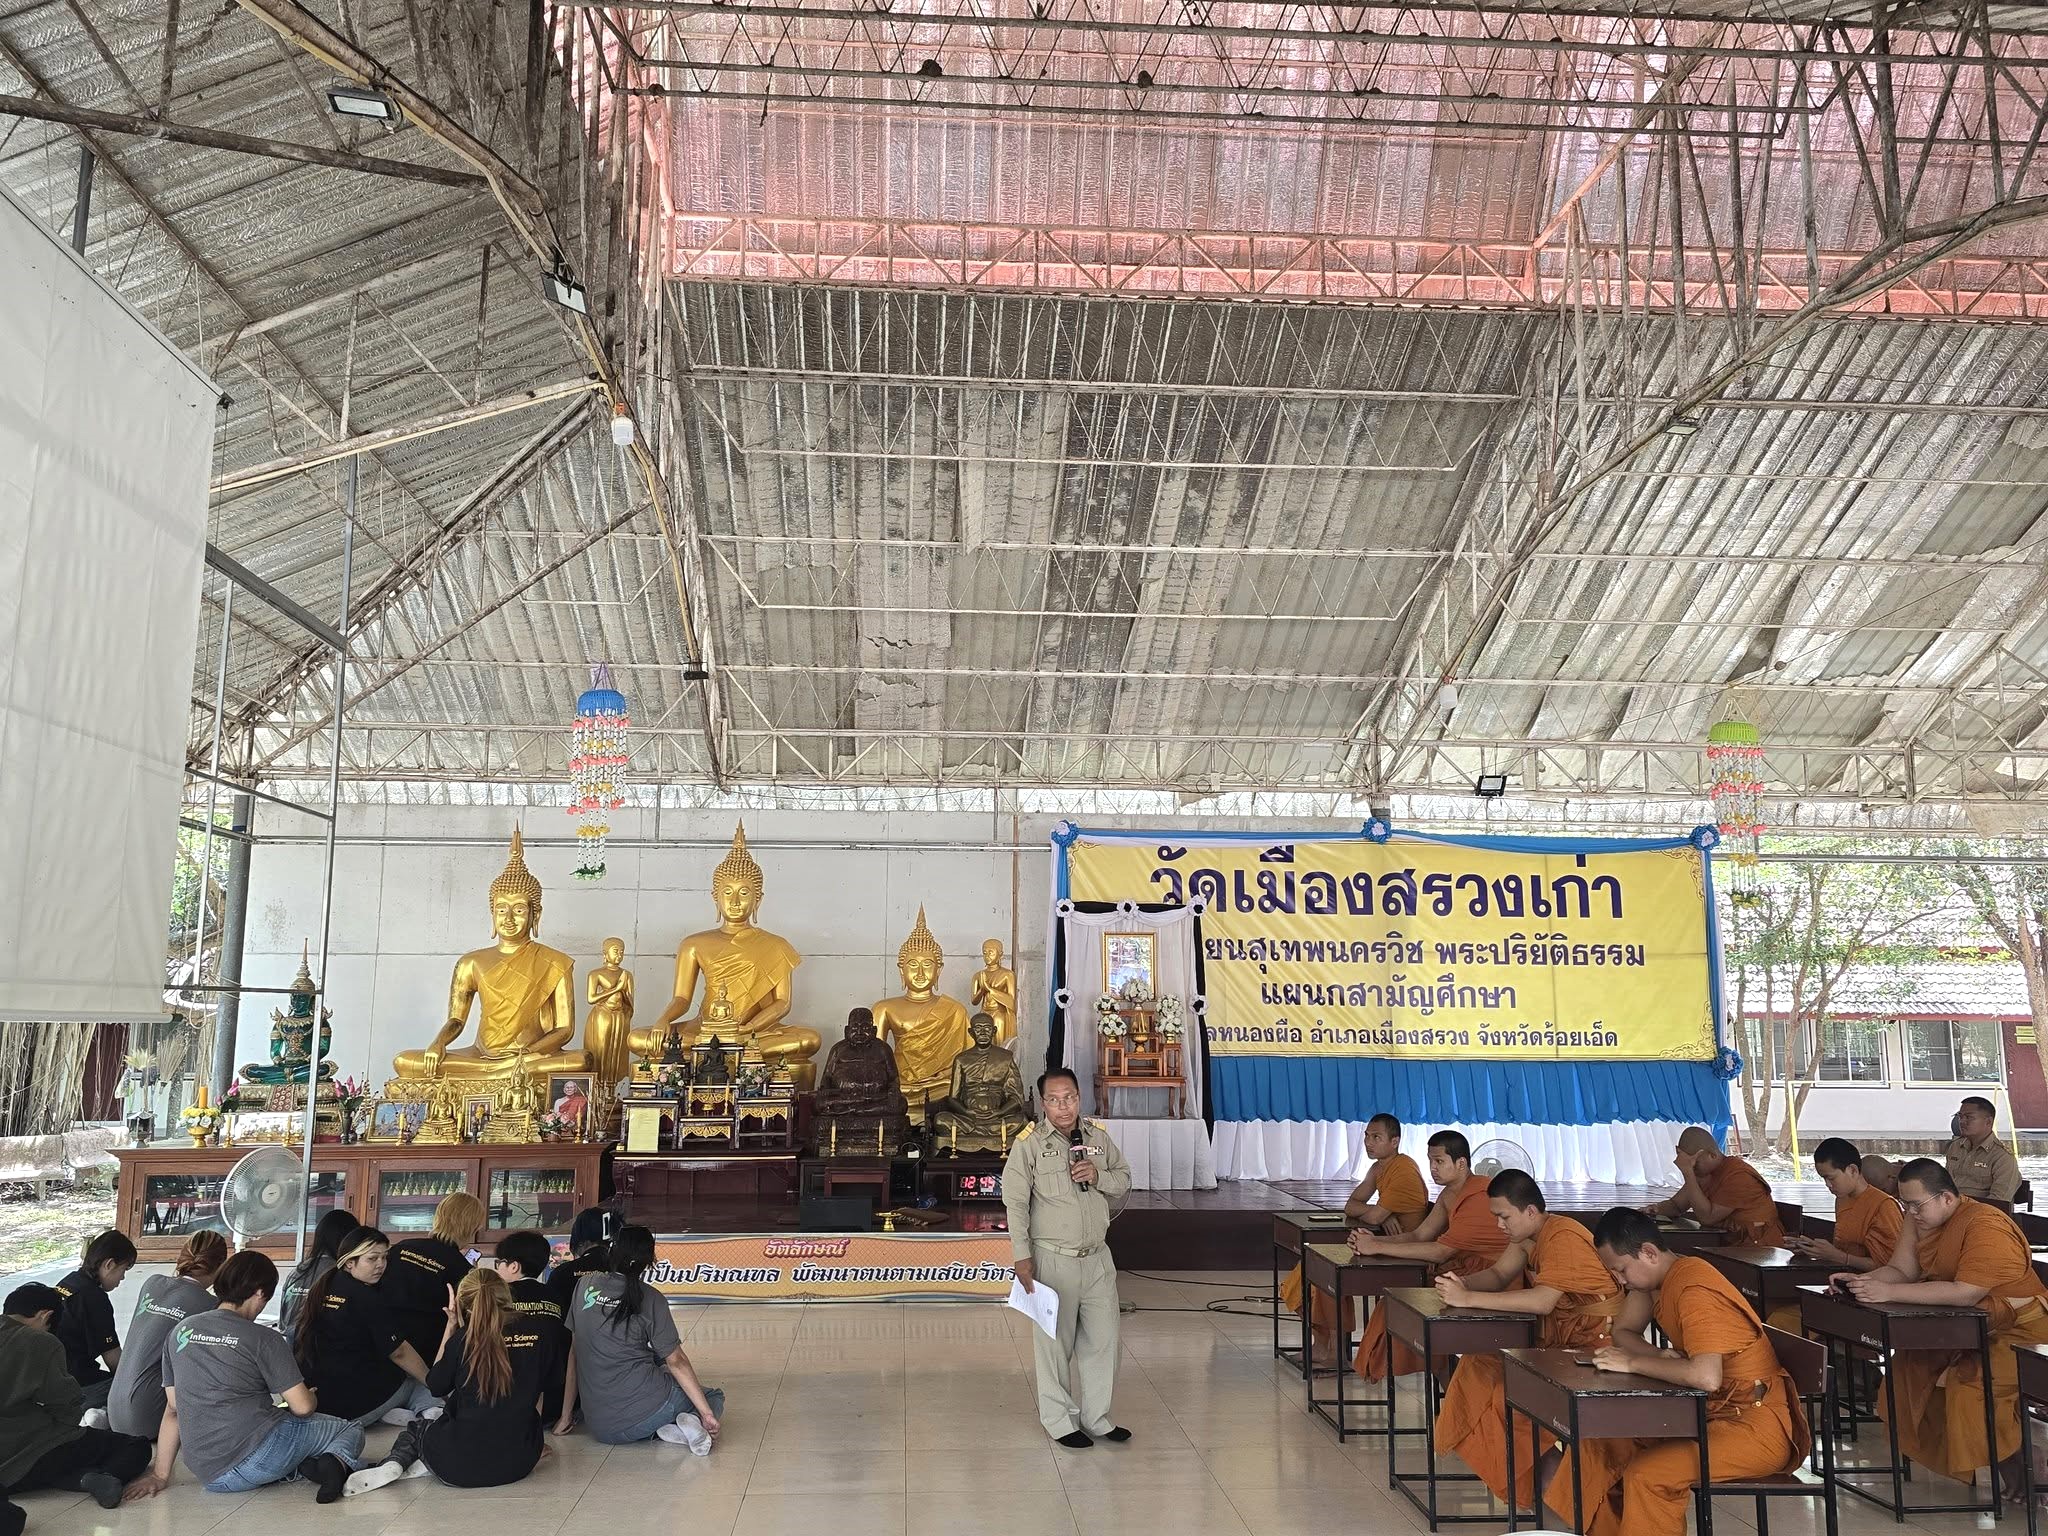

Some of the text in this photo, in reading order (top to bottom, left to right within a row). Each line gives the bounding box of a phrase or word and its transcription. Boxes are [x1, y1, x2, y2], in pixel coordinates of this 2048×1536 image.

[1435, 932, 1645, 966] พระปริยัติธรรม
[1261, 972, 1516, 1016] แผนกสามัญศึกษา
[1311, 1019, 1469, 1046] อำเภอเมืองสรวง
[1477, 1020, 1618, 1047] จังหวัดร้อยเอ็ด
[764, 1239, 850, 1257] อัตลักษณ์
[190, 1333, 238, 1346] Information
